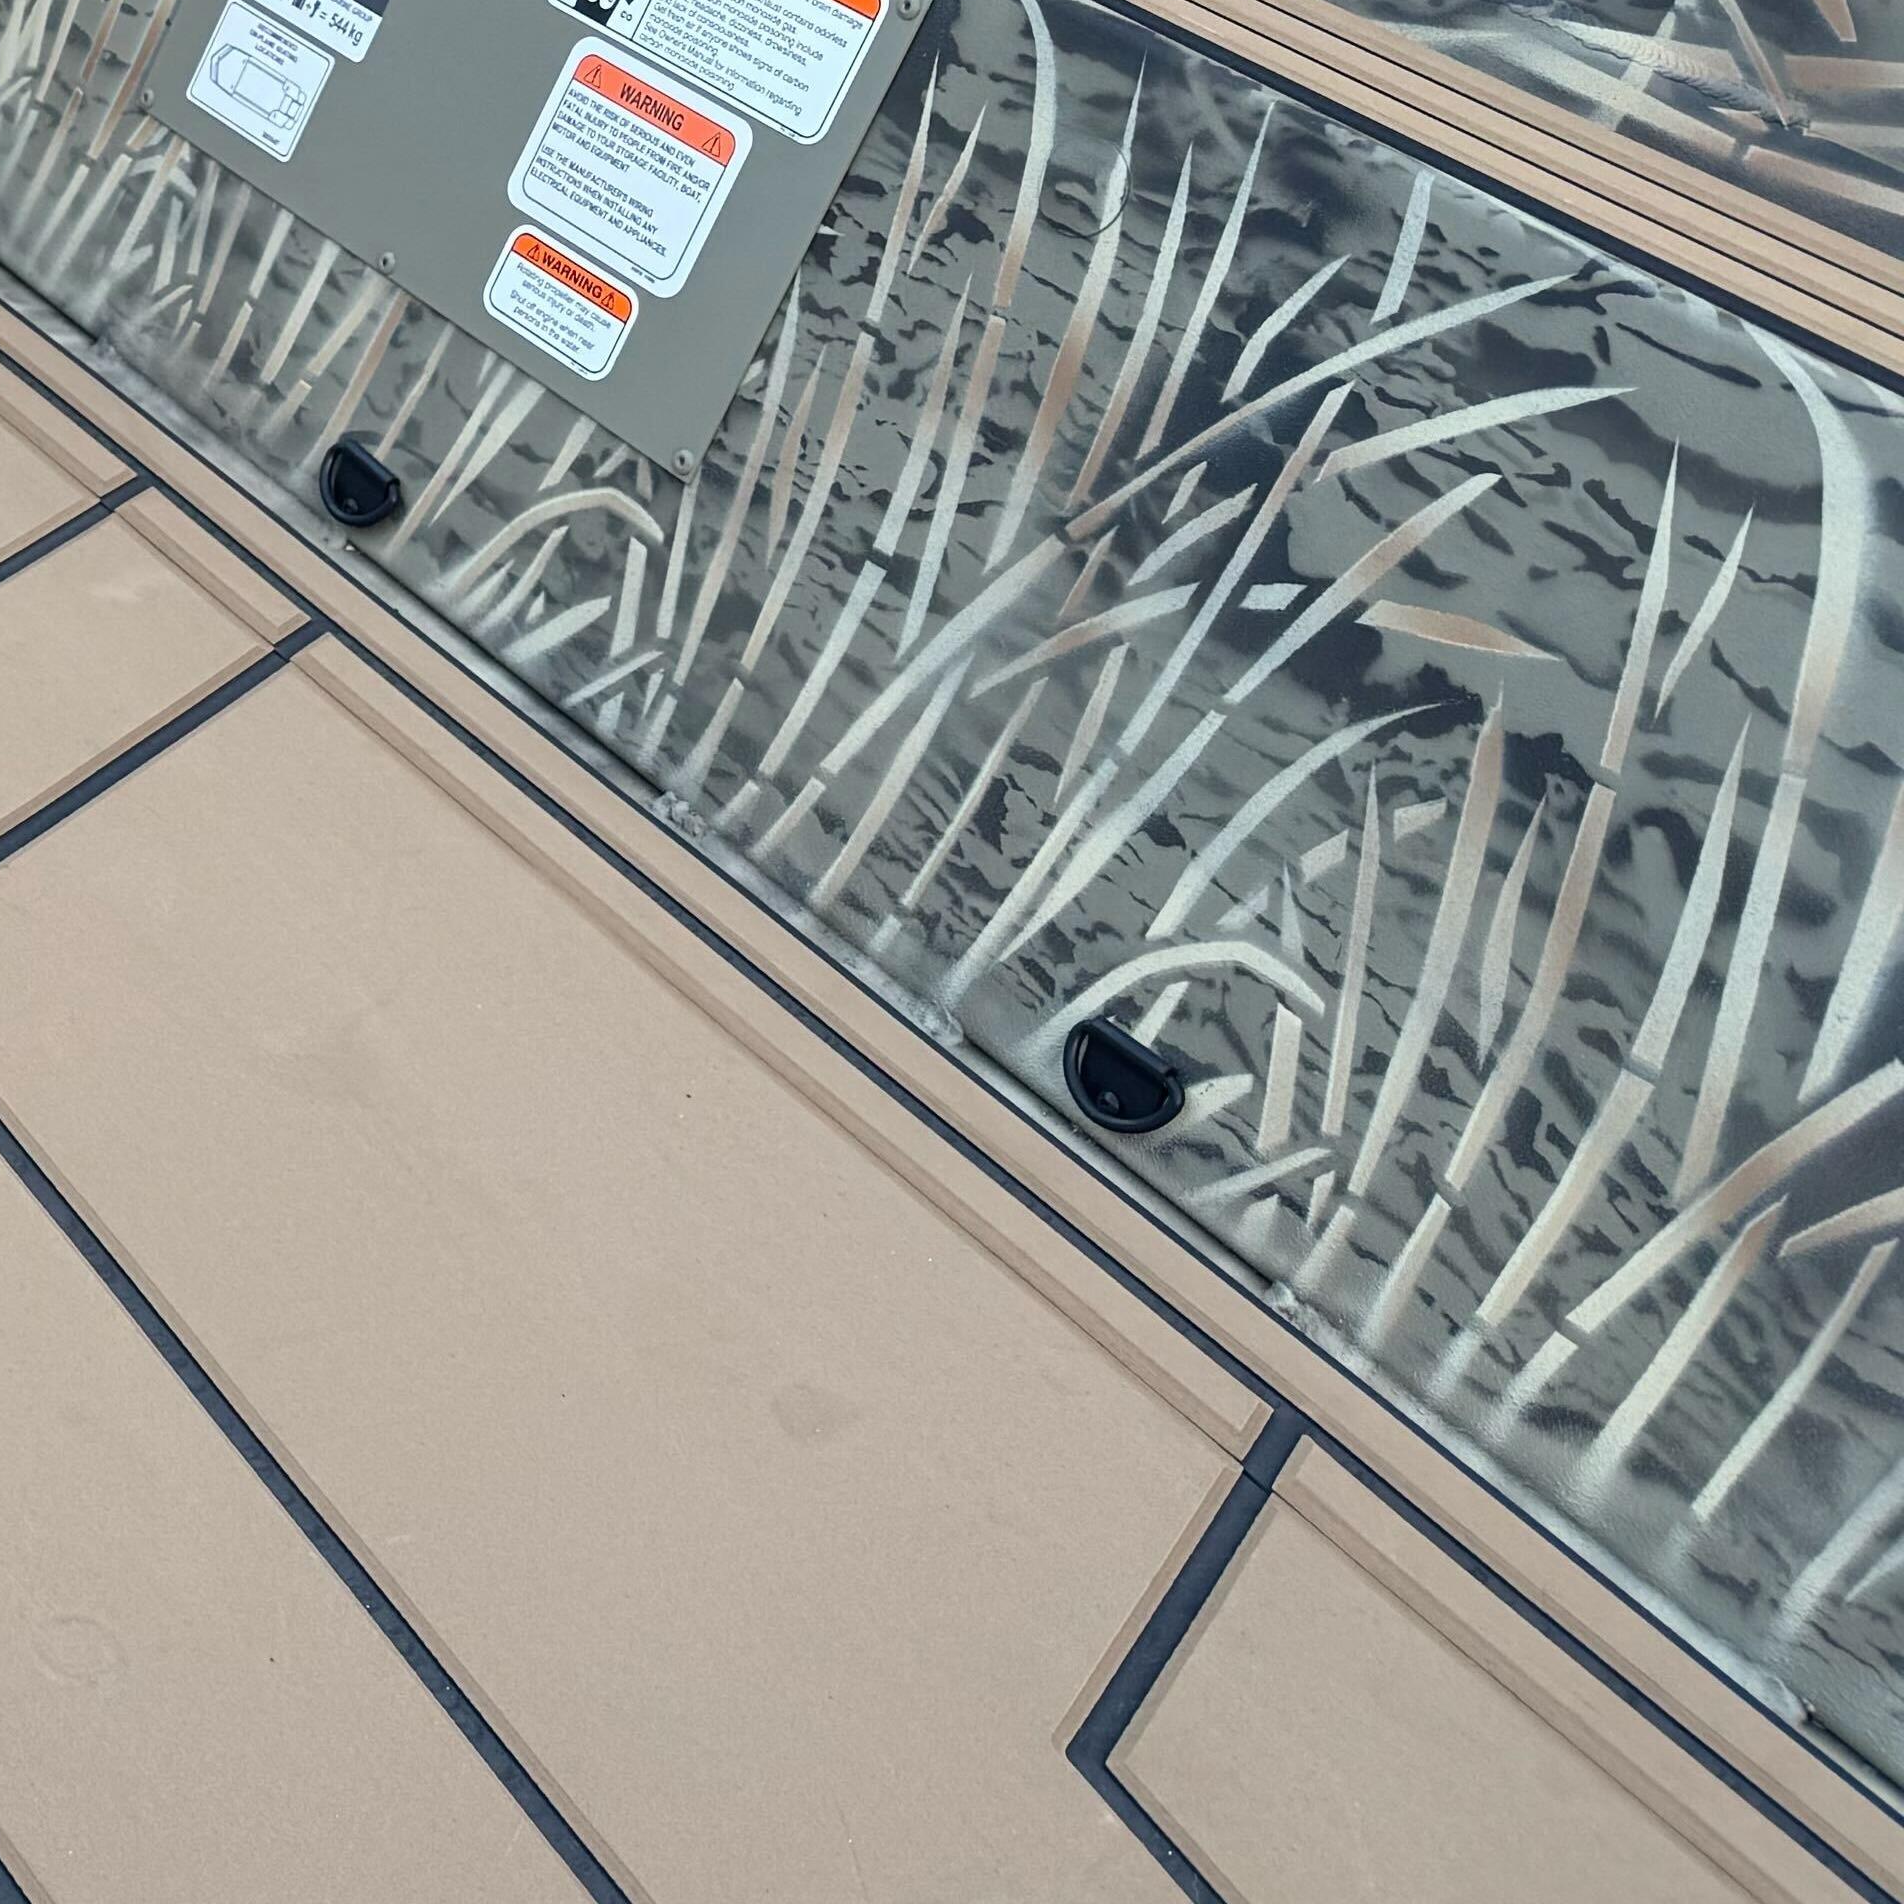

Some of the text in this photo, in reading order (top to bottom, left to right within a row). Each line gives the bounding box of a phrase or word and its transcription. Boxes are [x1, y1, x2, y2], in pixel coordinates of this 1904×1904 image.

[327, 12, 351, 35] 544
[345, 23, 365, 47] kg
[619, 9, 633, 22] CO
[830, 7, 864, 32] damage
[567, 87, 695, 167] AVOID THE RISK OF SERIOUS AND EVEN
[618, 82, 686, 132] WARNING
[551, 121, 576, 141] MOTOR
[575, 135, 591, 150] AND
[556, 110, 703, 203] DAMAGE TO YOUR STORAGE FACILITY, BOAT,
[562, 99, 583, 117] FATAL
[583, 111, 608, 131] INJURY
[607, 125, 619, 138] TO
[617, 131, 646, 153] PEOPLE
[644, 147, 666, 165] FROM
[665, 159, 683, 175] FIRE
[529, 166, 570, 196] ELECTRICAL
[569, 190, 608, 220] EQUIPMENT
[607, 214, 624, 229] AND
[535, 155, 658, 235] INSTRUCTIONS WHEN INSTALLING ANY
[540, 143, 555, 157] USE
[554, 152, 569, 166] THE
[627, 196, 654, 218] WIRING
[540, 251, 604, 299] WARNING
